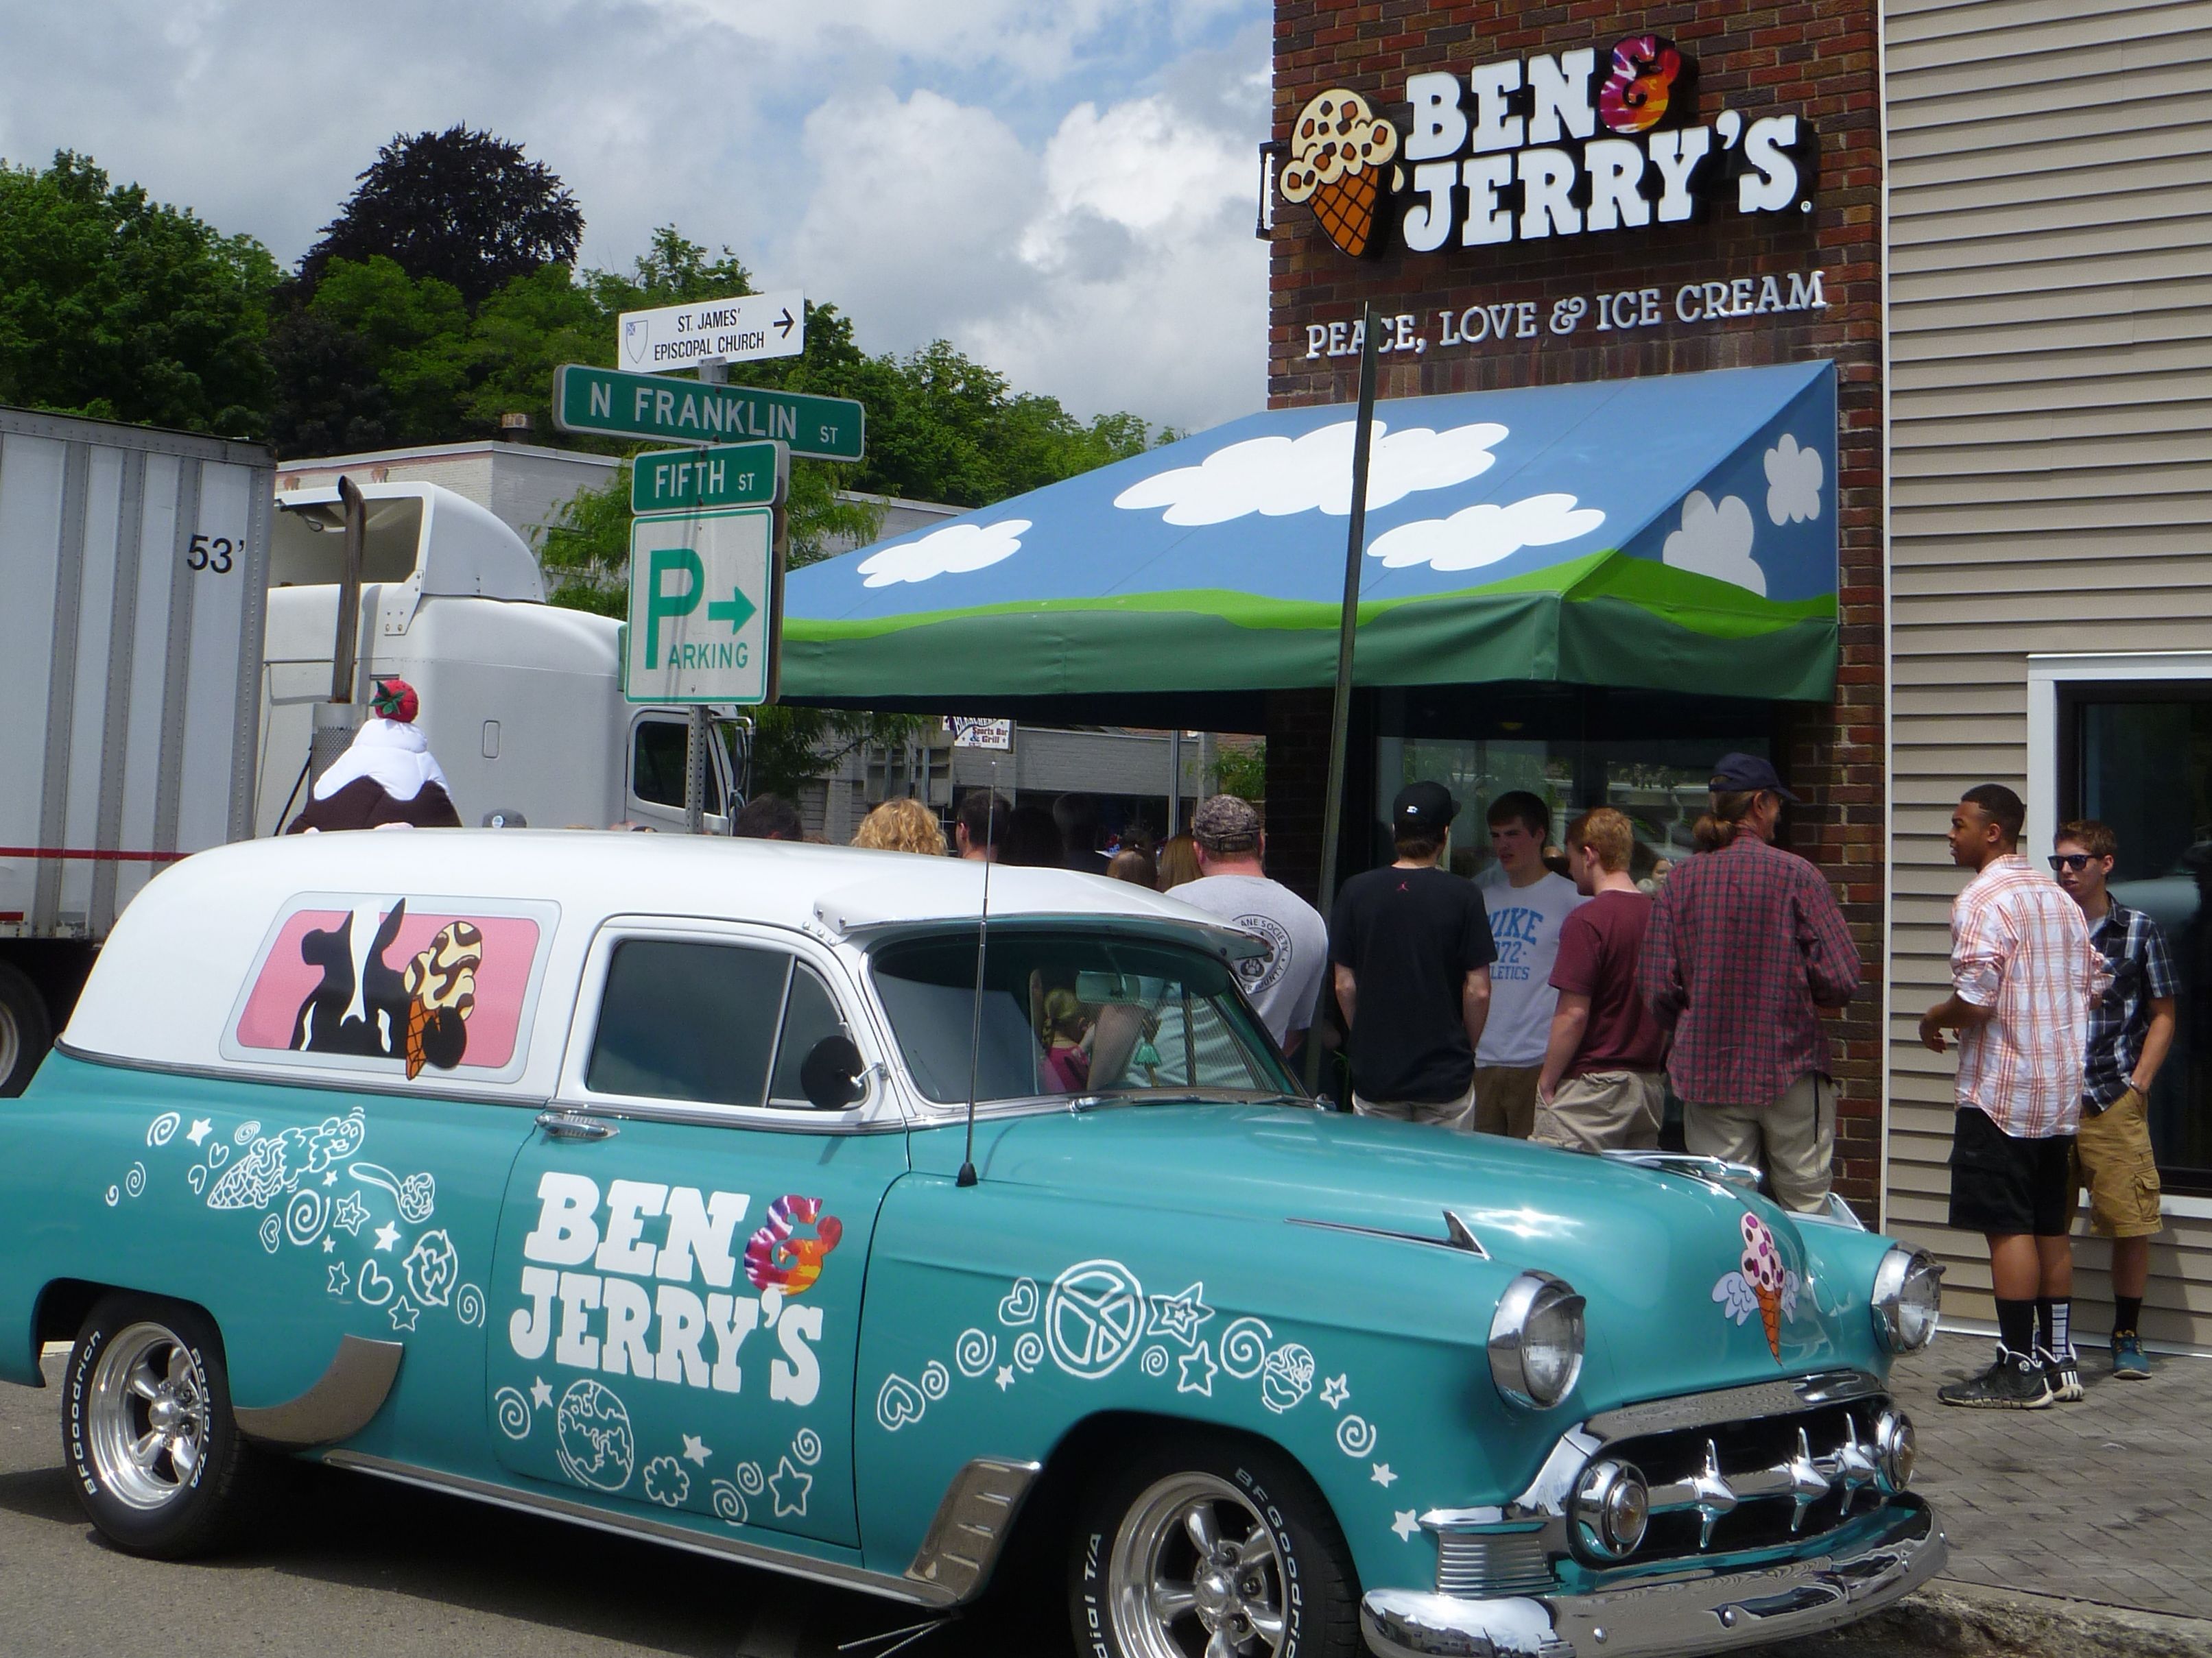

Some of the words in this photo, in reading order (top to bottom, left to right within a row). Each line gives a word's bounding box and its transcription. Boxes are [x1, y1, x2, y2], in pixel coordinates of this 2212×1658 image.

[1405, 47, 1595, 160] BEN
[1599, 34, 1682, 133] &
[1403, 110, 1798, 252] JERRY'S
[677, 314, 693, 333] ST.
[697, 307, 741, 331] JAMES'
[1438, 302, 1538, 346] LOVE
[1548, 296, 1589, 335] &
[1595, 288, 1663, 331] ICE
[1675, 270, 1828, 324] CREAM
[654, 336, 713, 361] EPISCOPAL
[717, 332, 765, 352] CHURCH
[591, 381, 611, 418] N
[634, 387, 797, 440] FRANKLIN
[820, 427, 838, 444] ST
[655, 459, 725, 499] FIFTH
[738, 473, 755, 492] ST
[970, 734, 980, 742] &
[973, 727, 994, 736] Sports
[996, 728, 1008, 736] Bar
[1241, 918, 1258, 927] ANE
[1261, 920, 1289, 952] SOCIETY
[1490, 965, 1530, 981] LETICS
[523, 1171, 750, 1288] BEN
[744, 1194, 843, 1296] &
[509, 1266, 824, 1406] JERRY'S
[1084, 1533, 1102, 1581] T/A
